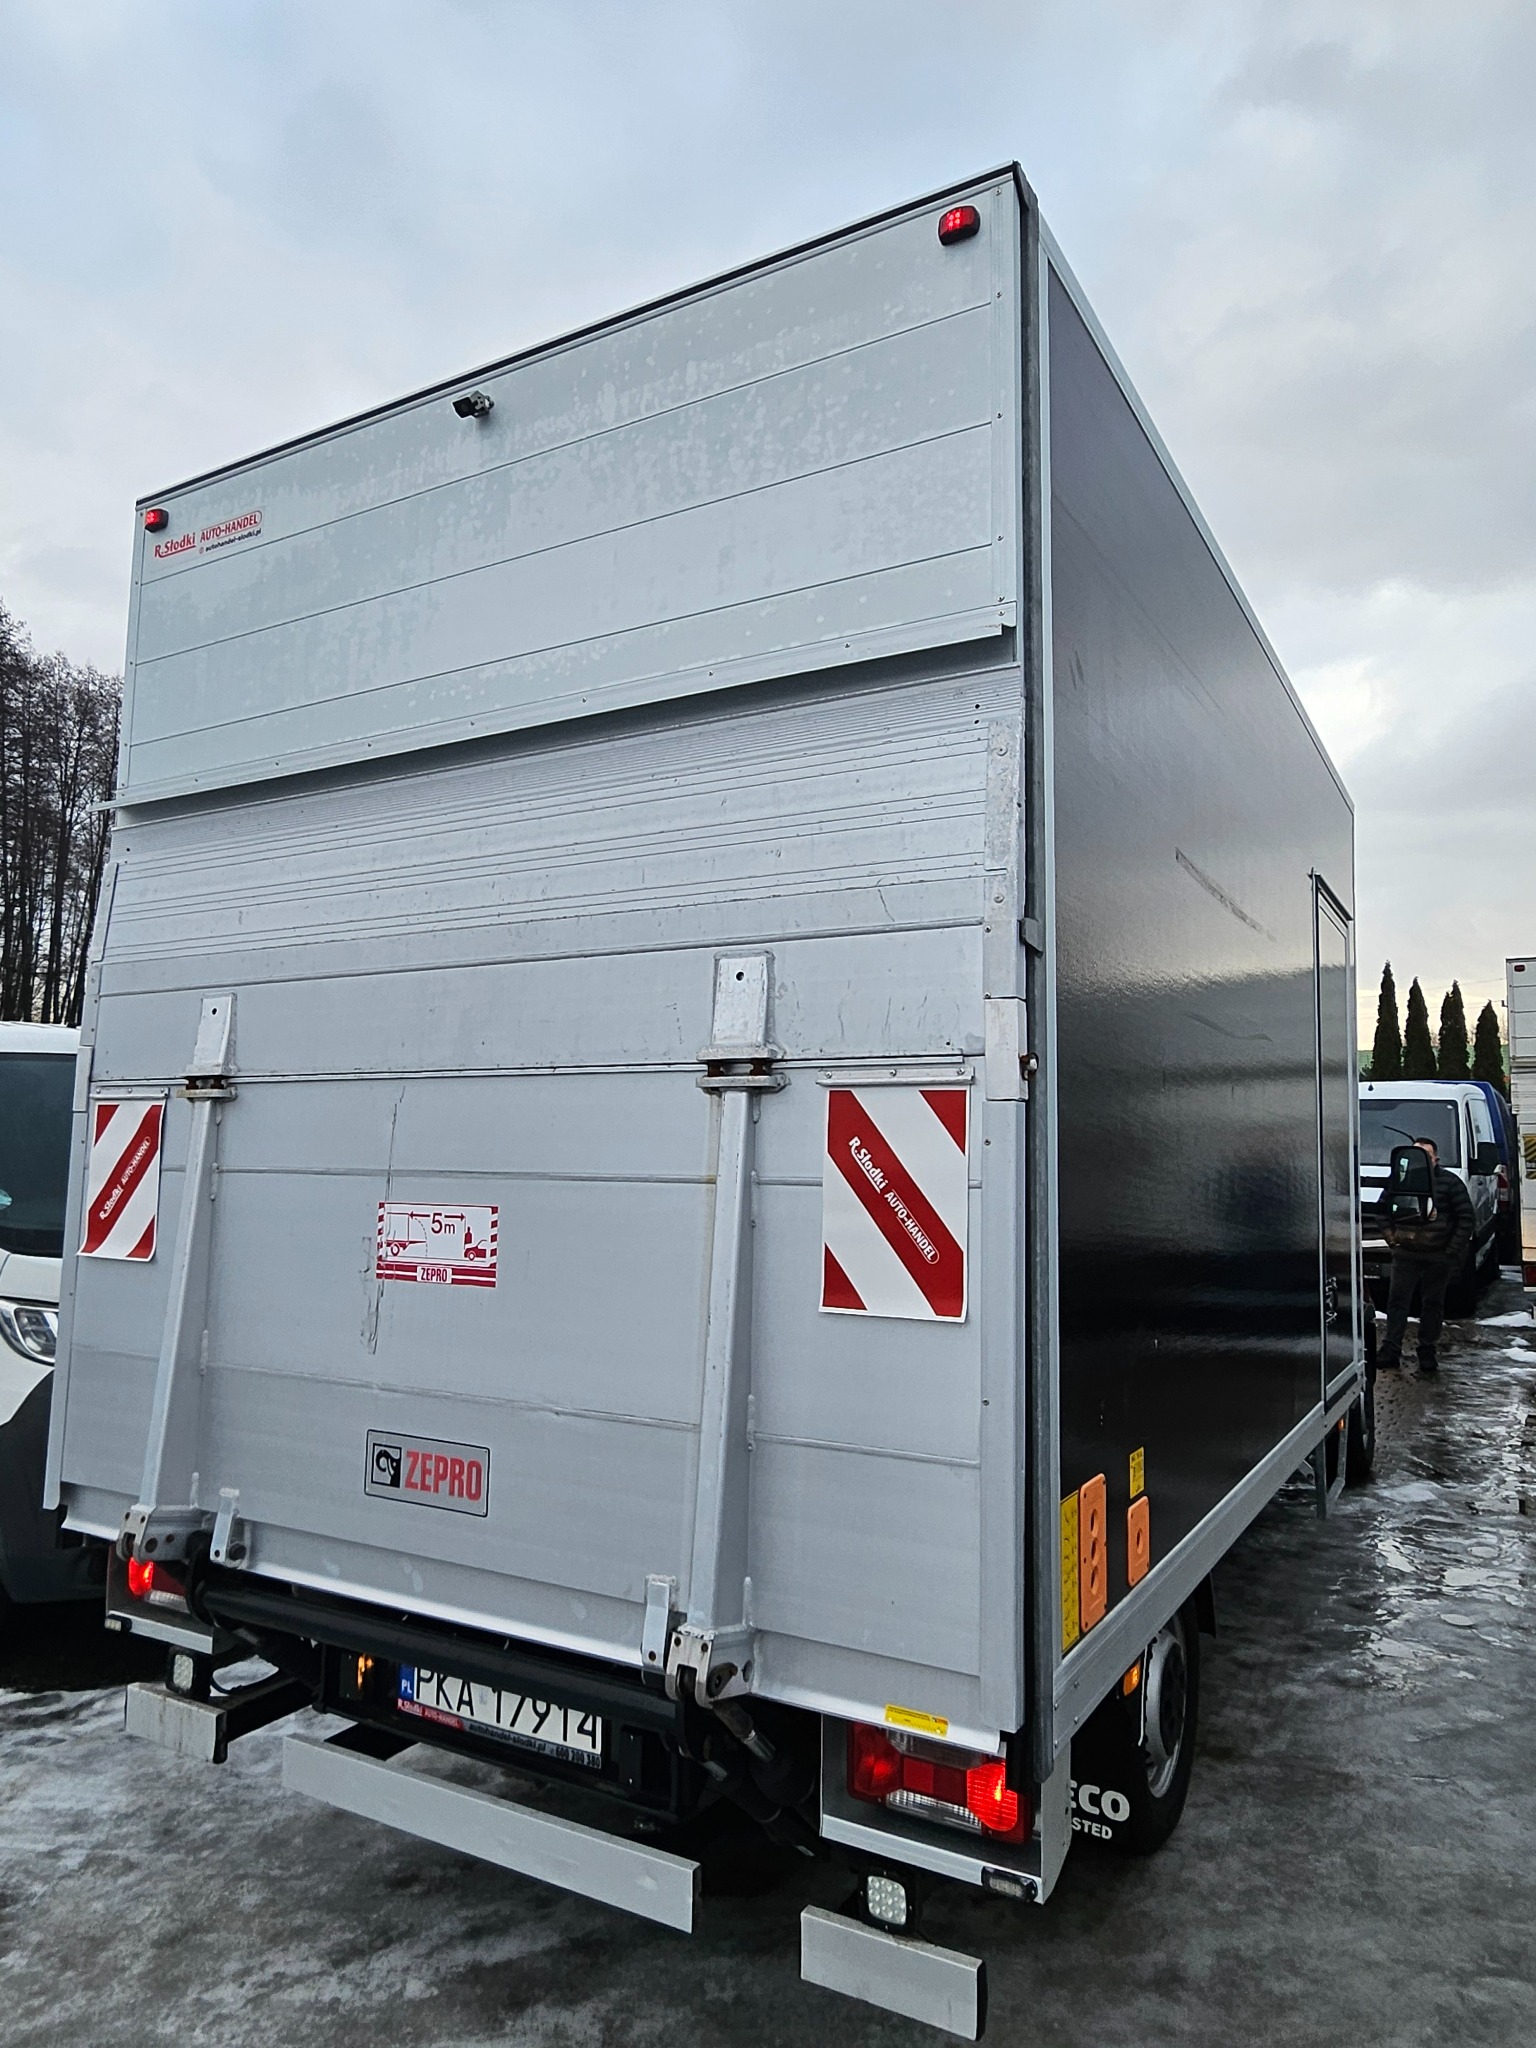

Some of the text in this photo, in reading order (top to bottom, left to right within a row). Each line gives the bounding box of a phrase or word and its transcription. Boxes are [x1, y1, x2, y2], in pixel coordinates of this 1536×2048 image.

[200, 513, 259, 543] AUTO-HANDEL
[884, 1190, 937, 1261] AUTO-HANDEL
[420, 1267, 448, 1283] ZEPRO
[404, 1449, 483, 1502] ZEPRO
[401, 1679, 413, 1694] PL
[416, 1667, 476, 1717] PKA
